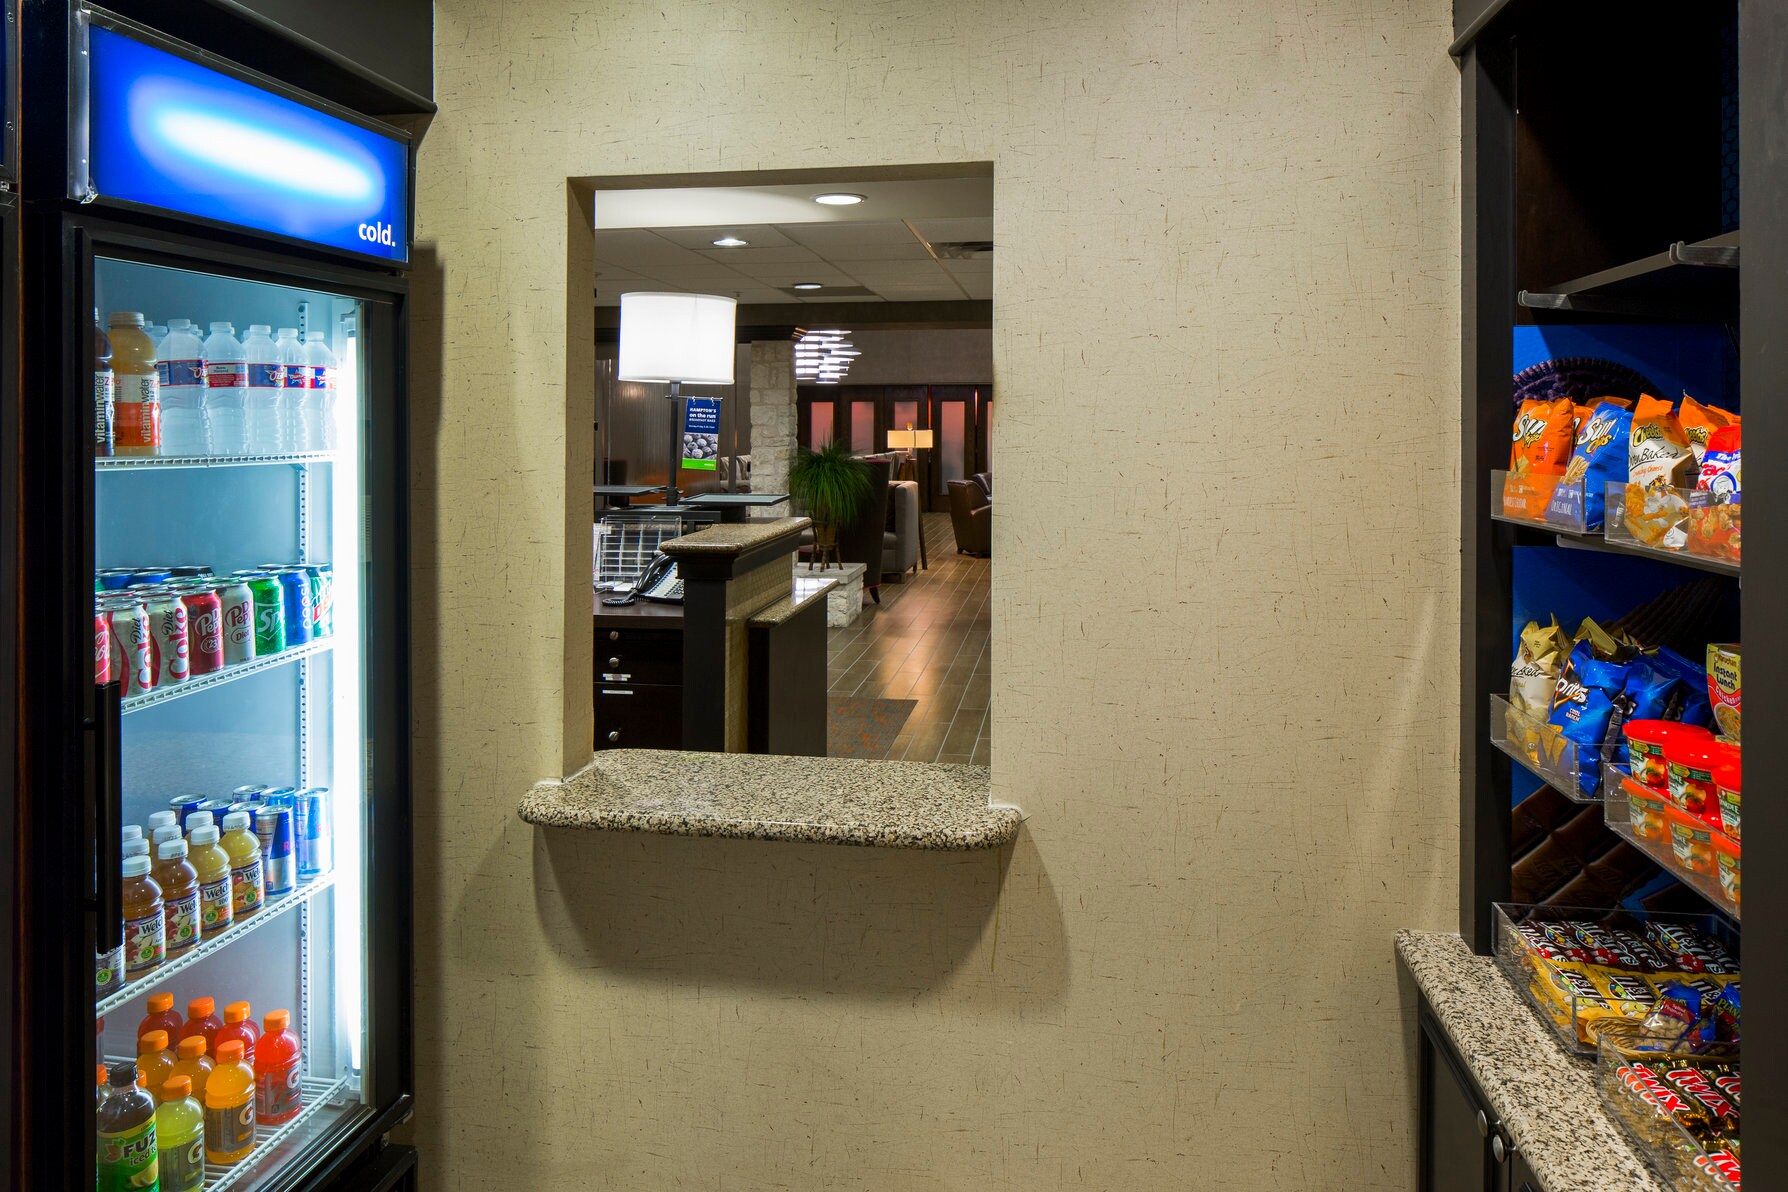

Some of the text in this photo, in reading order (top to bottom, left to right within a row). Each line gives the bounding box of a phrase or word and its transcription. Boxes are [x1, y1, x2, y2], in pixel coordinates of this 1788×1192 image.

[358, 221, 396, 247] cold.
[1576, 417, 1618, 445] Sun
[161, 608, 174, 635] Diet
[297, 582, 313, 629] pepsi
[130, 618, 142, 644] Diet
[168, 607, 188, 679] Coke
[137, 615, 151, 689] Coke
[1716, 673, 1736, 691] Lunch
[1616, 1063, 1691, 1118] TWIX
[1665, 1066, 1740, 1119] TWIX
